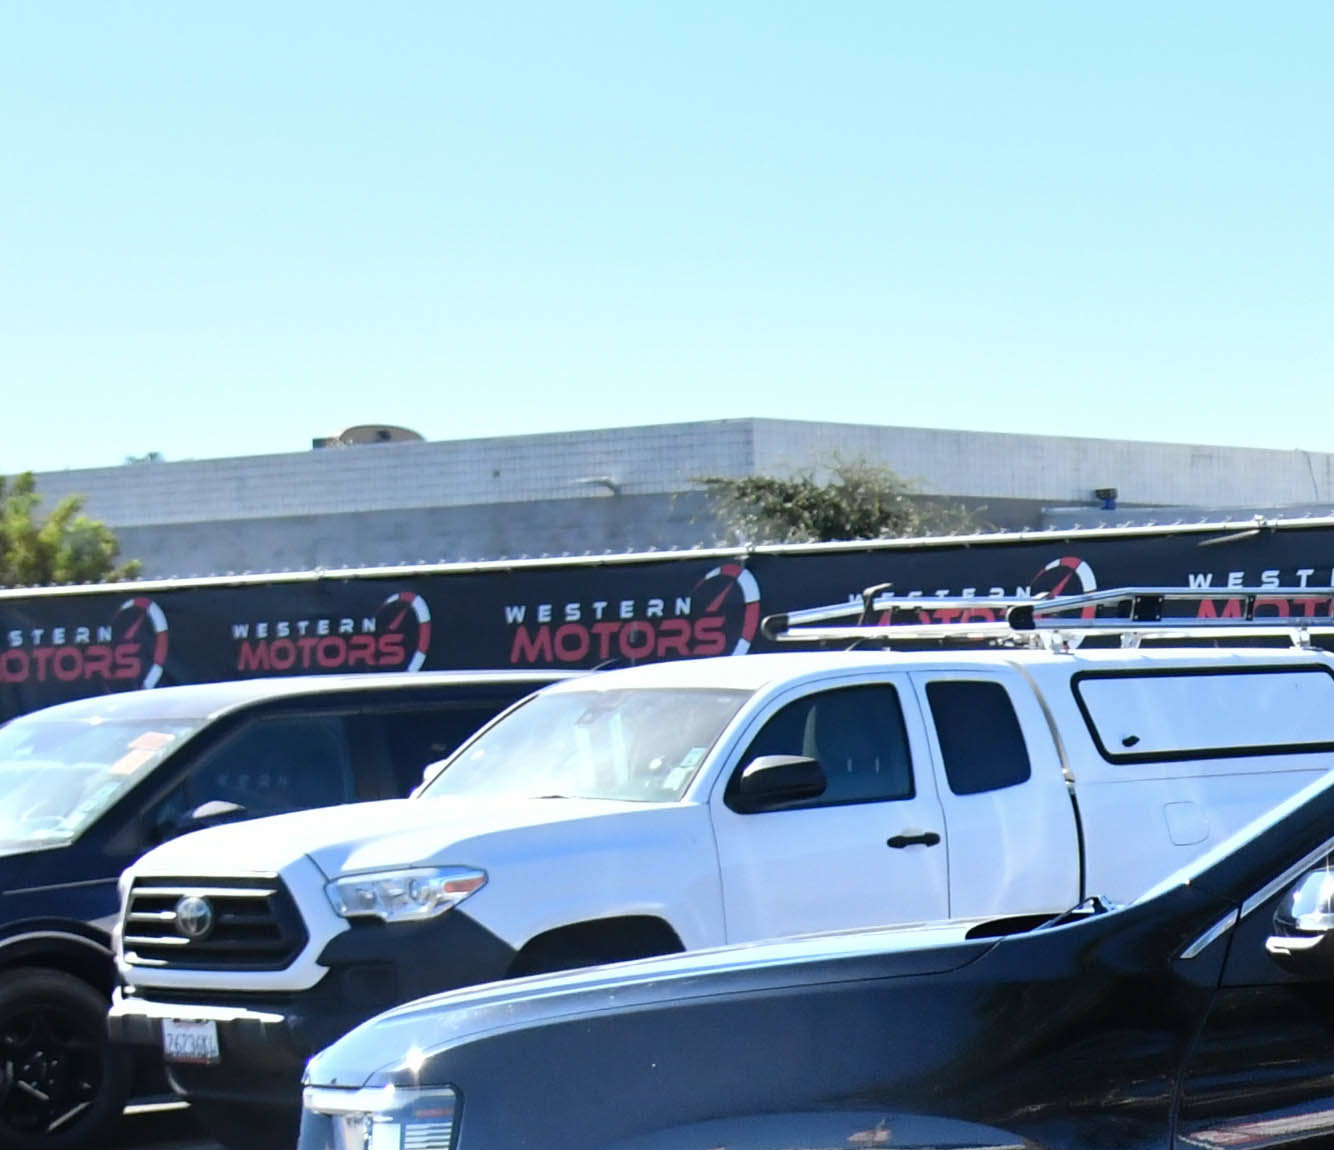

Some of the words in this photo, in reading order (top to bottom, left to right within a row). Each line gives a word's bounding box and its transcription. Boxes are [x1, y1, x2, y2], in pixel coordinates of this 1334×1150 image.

[505, 597, 691, 624] WESTERN
[232, 617, 377, 639] WESTERN
[510, 616, 727, 664] MOTORS
[237, 633, 406, 671] MOTORS
